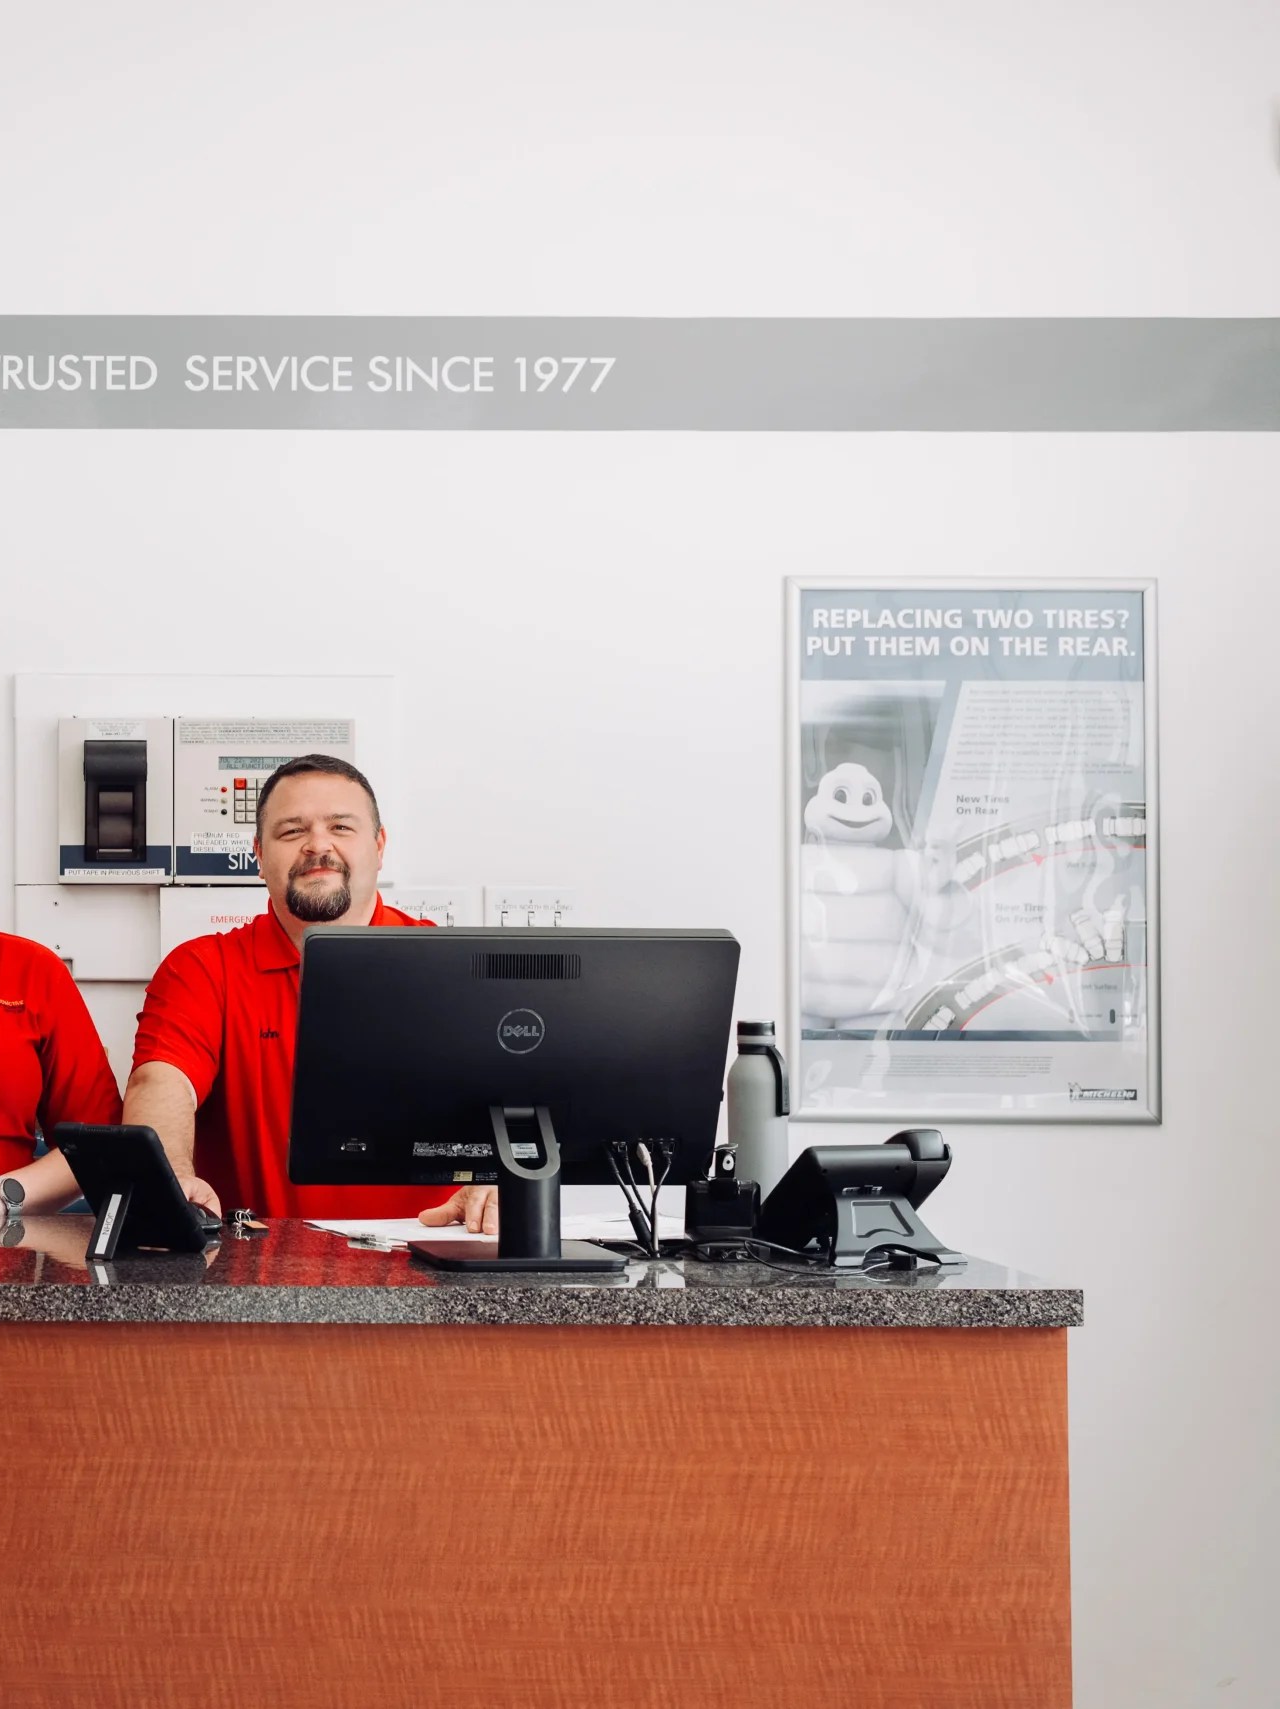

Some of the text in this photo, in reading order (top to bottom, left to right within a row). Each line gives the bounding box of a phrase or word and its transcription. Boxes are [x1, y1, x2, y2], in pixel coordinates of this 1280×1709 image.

[184, 354, 353, 392] SERVICE
[367, 355, 494, 392] SINCE
[513, 356, 617, 393] 1977
[812, 608, 1130, 630] REPLACING TWO TIRES?
[806, 636, 1136, 656] PUT THEM ON THE REAR.
[956, 794, 1010, 804] New Tires
[956, 806, 999, 815] On Rear
[193, 831, 224, 839] PREMIUM
[228, 853, 261, 870] SIM
[210, 915, 254, 924] EMERGEN
[502, 1024, 540, 1038] DELL
[102, 1212, 115, 1236] JOHN
